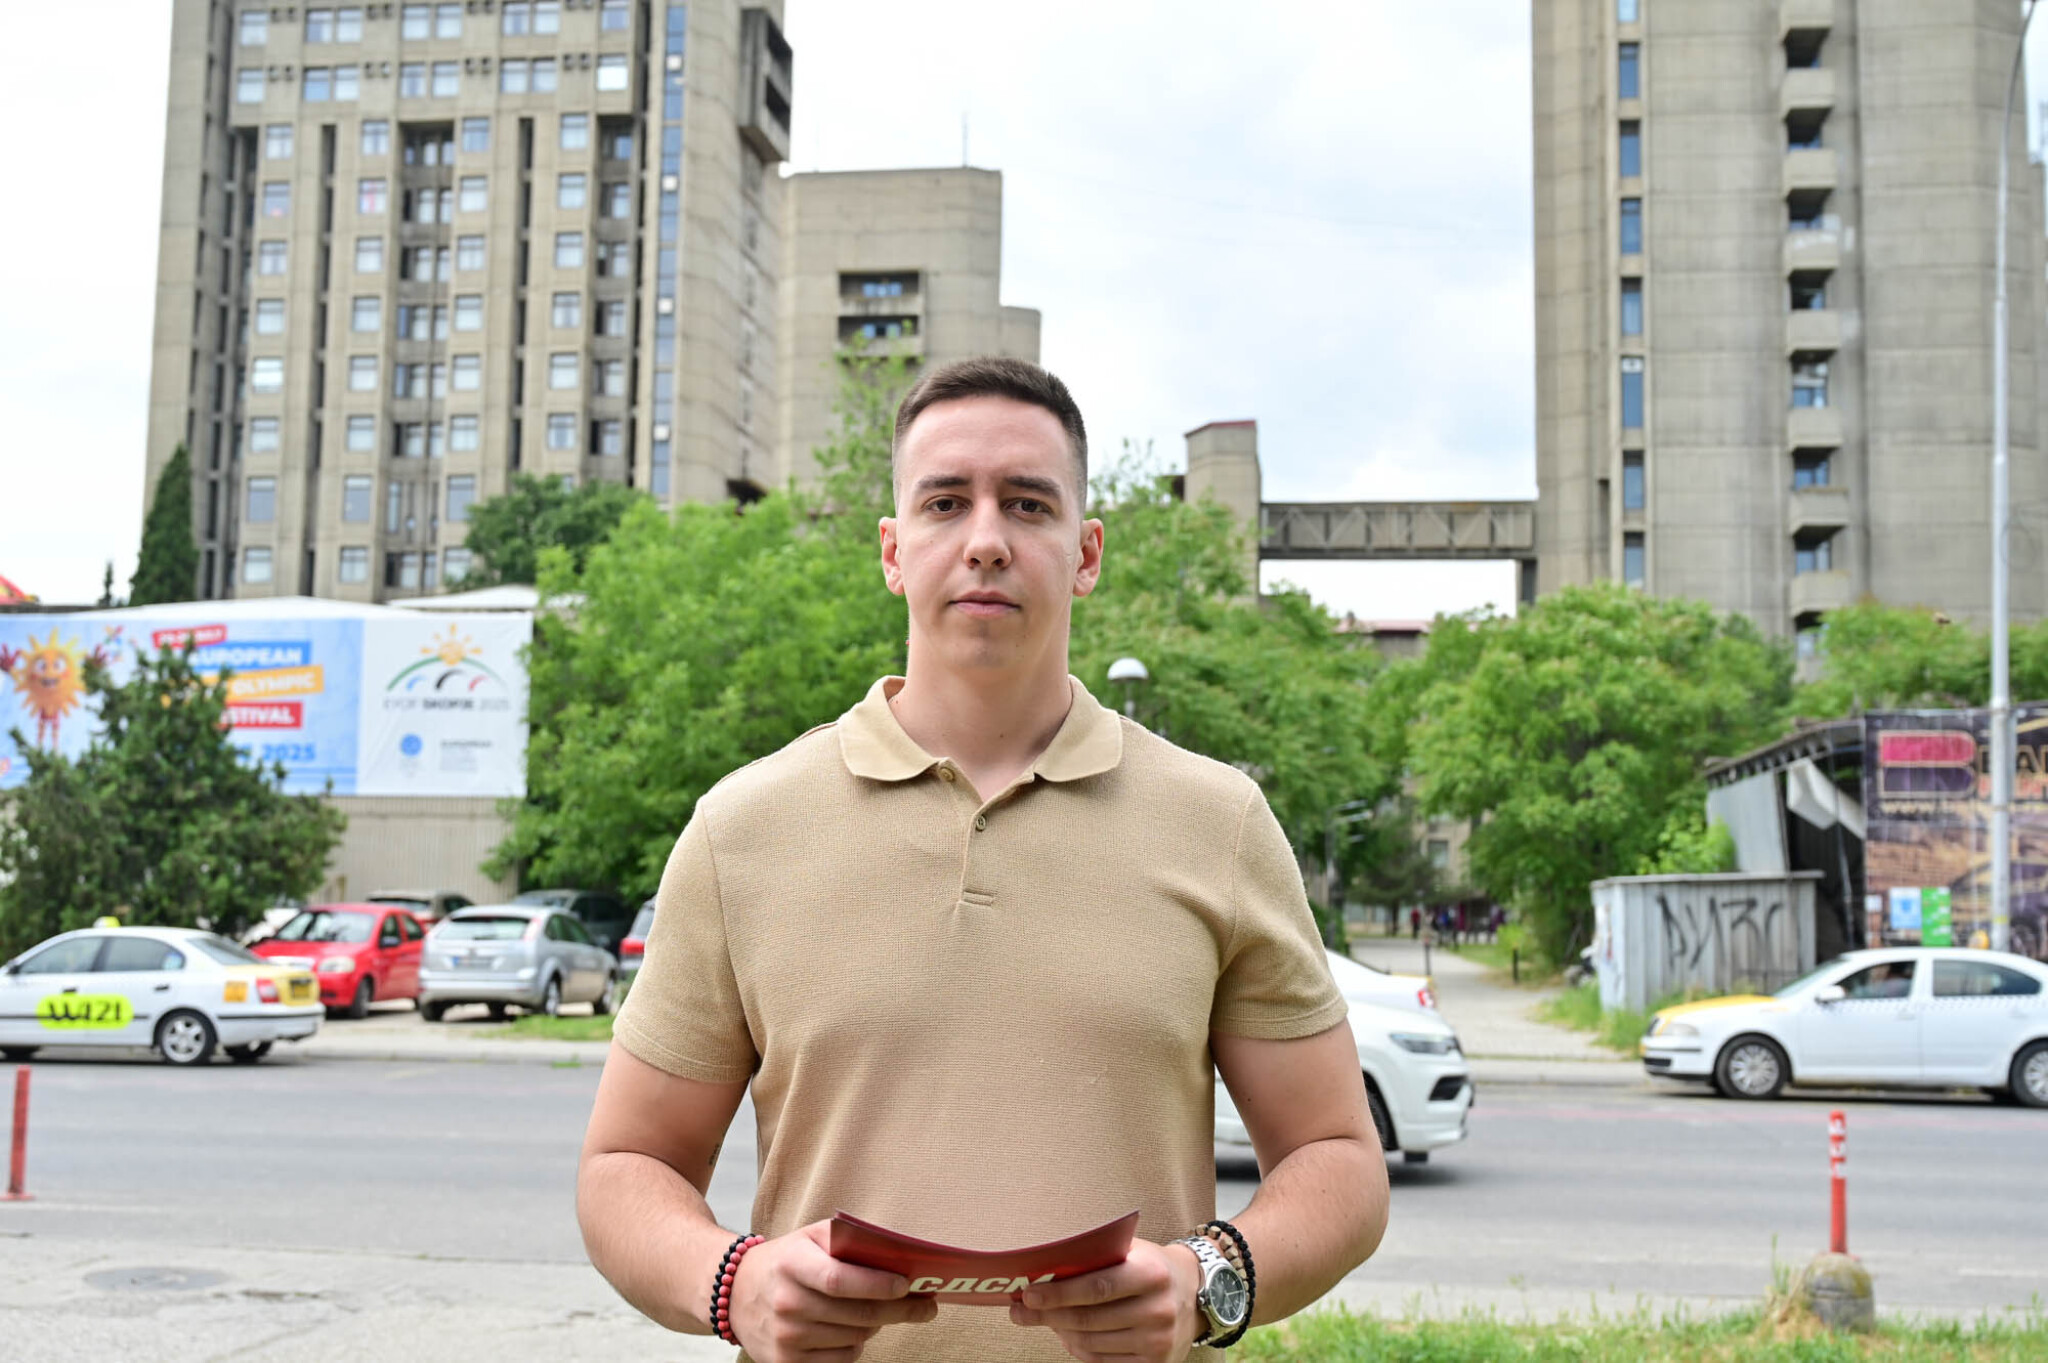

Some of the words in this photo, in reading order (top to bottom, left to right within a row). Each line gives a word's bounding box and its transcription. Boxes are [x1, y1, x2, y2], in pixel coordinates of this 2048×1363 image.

[232, 673, 315, 696] OLYMPIC
[221, 706, 295, 724] STIVAL
[262, 743, 317, 761] 2025
